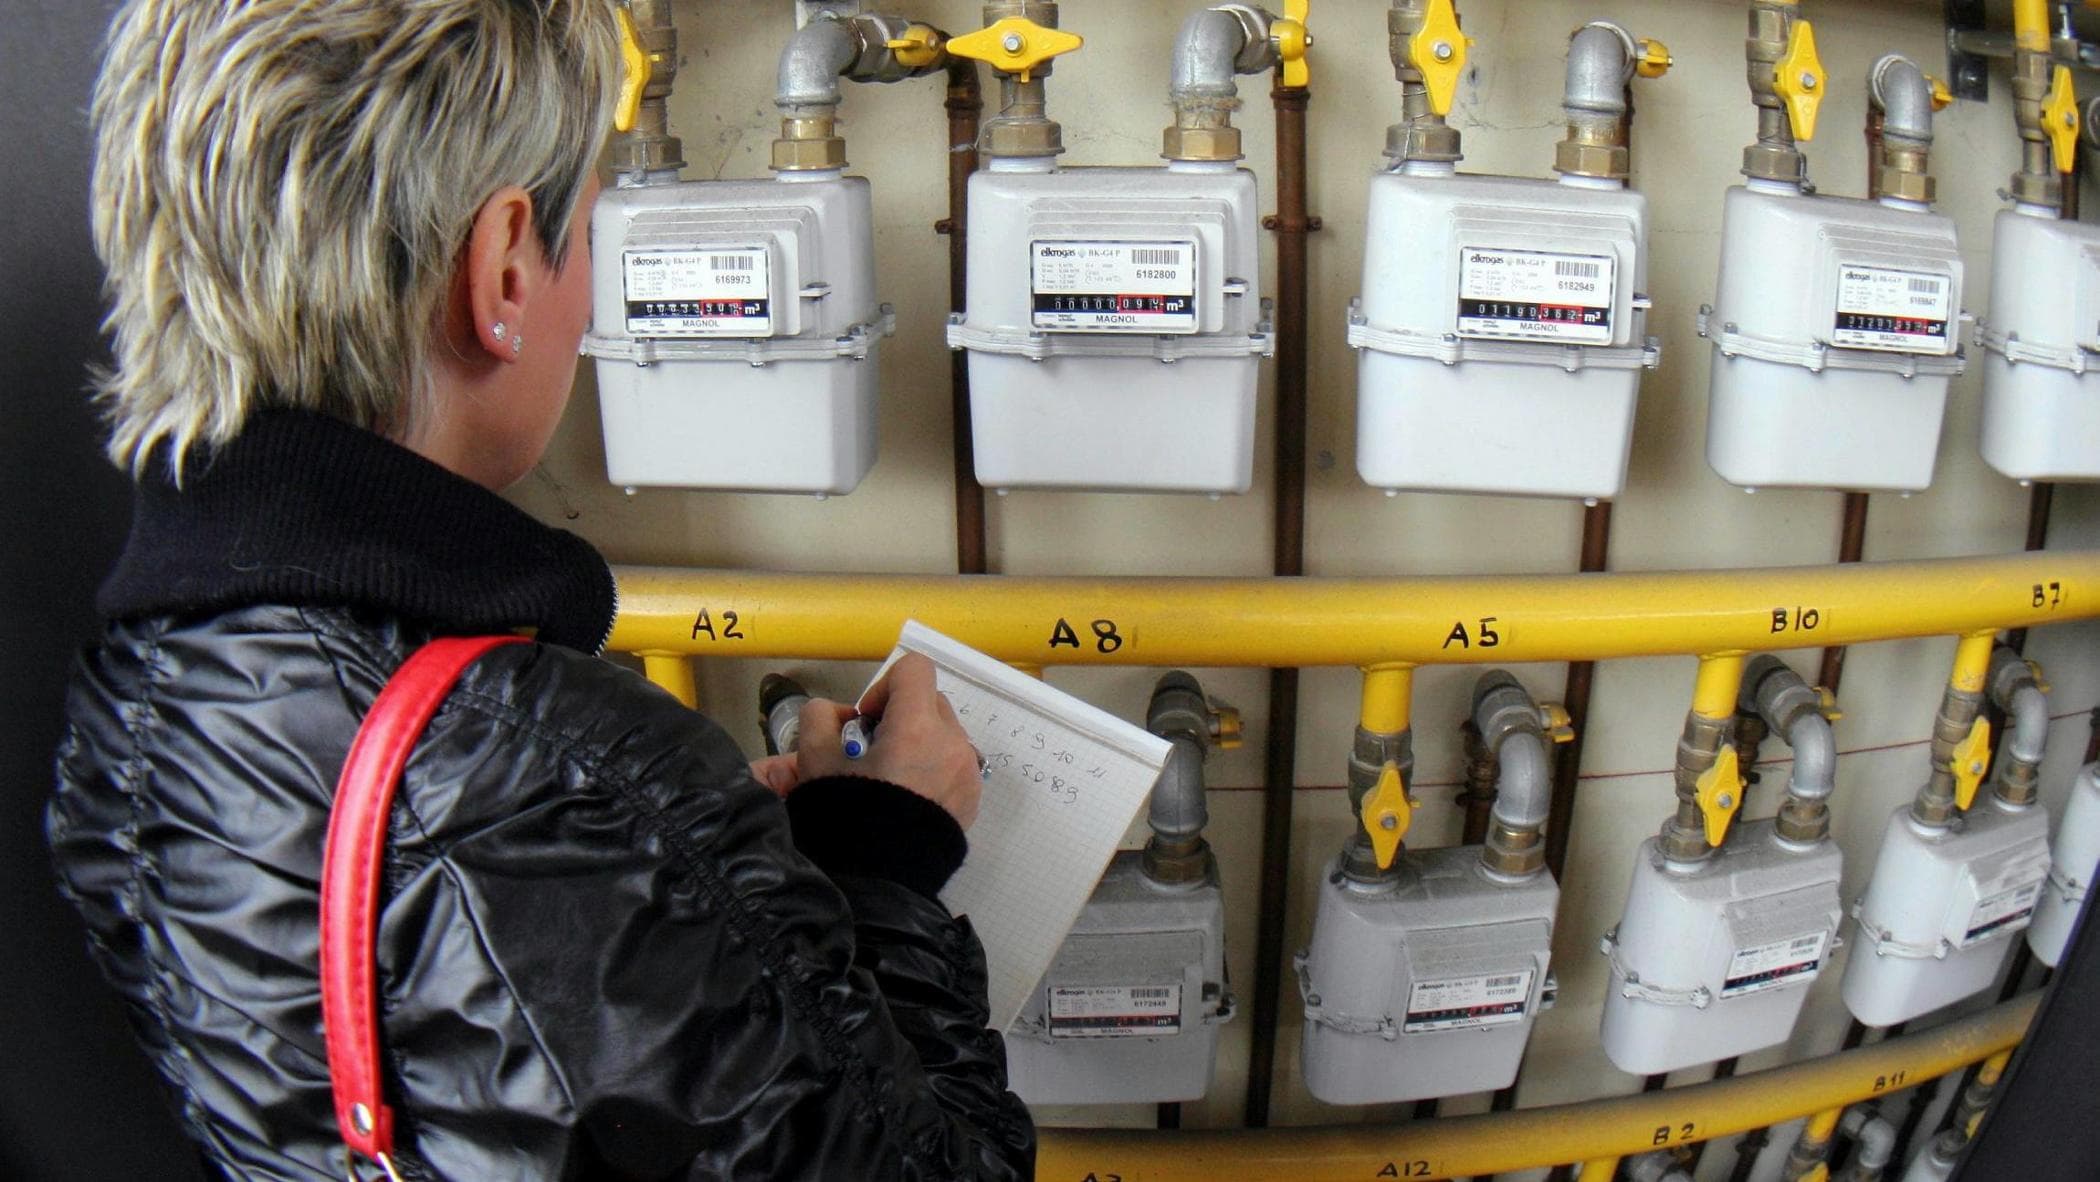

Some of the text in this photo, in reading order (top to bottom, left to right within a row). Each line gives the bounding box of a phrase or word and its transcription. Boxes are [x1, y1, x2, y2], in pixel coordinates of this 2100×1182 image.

[715, 275, 751, 284] 6169973
[1136, 269, 1176, 279] 6182800
[1558, 281, 1595, 292] 6182949
[1096, 315, 1138, 324] MAGNOL
[1519, 322, 1559, 332] MAGNOL
[2032, 582, 2060, 610] B7
[691, 607, 743, 641] A2
[1770, 607, 1819, 634] B10
[1442, 616, 1500, 649] A5
[1376, 1161, 1431, 1178] A12
